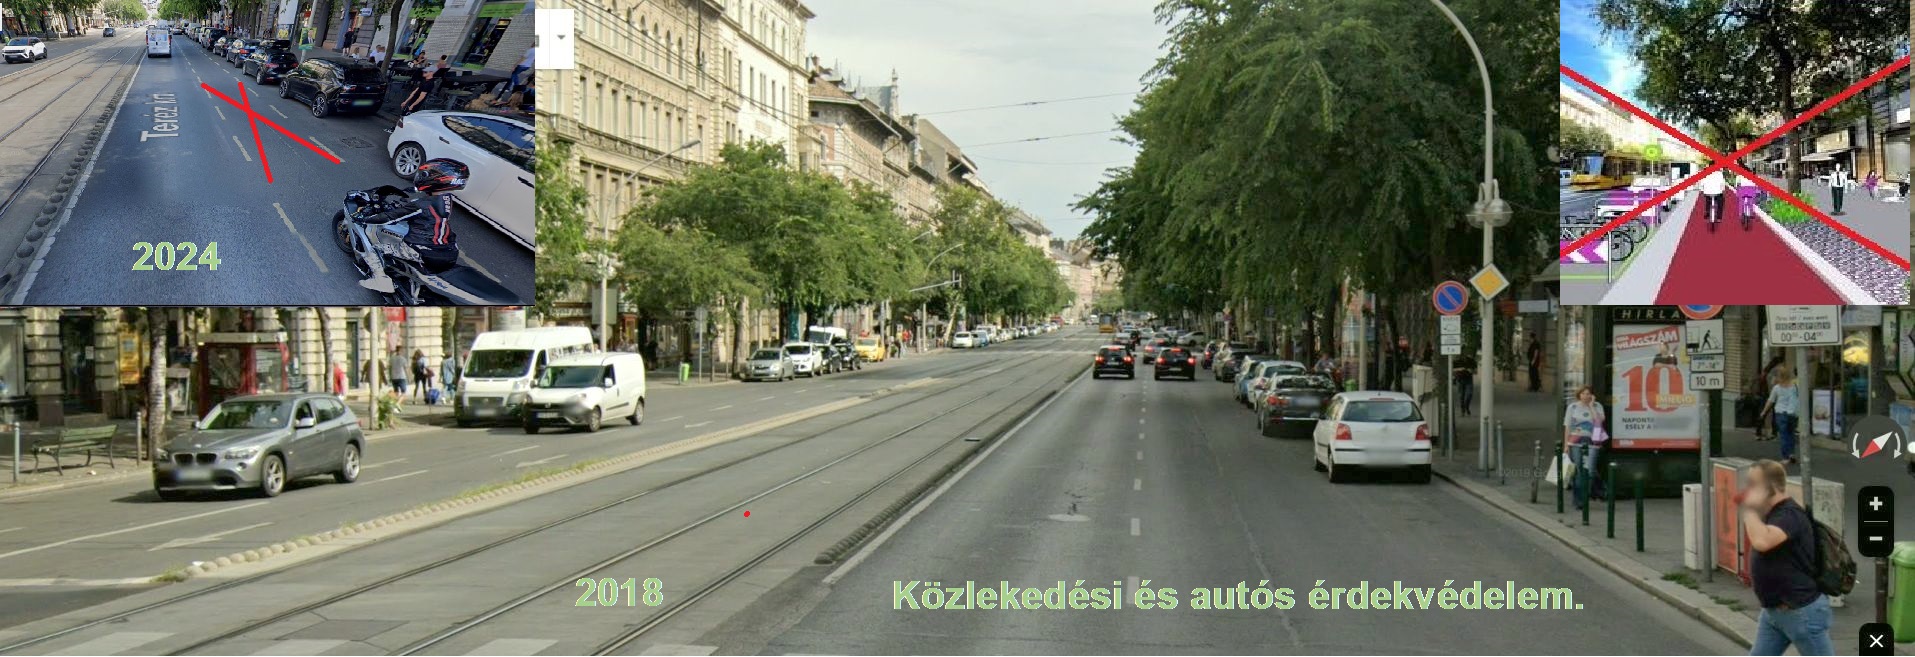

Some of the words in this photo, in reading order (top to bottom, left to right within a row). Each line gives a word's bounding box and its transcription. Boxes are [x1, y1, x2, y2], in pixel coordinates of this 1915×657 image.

[140, 106, 179, 142] Teréz
[1621, 365, 1684, 413] 10
[1696, 375, 1706, 387] 10
[1709, 377, 1720, 386] m
